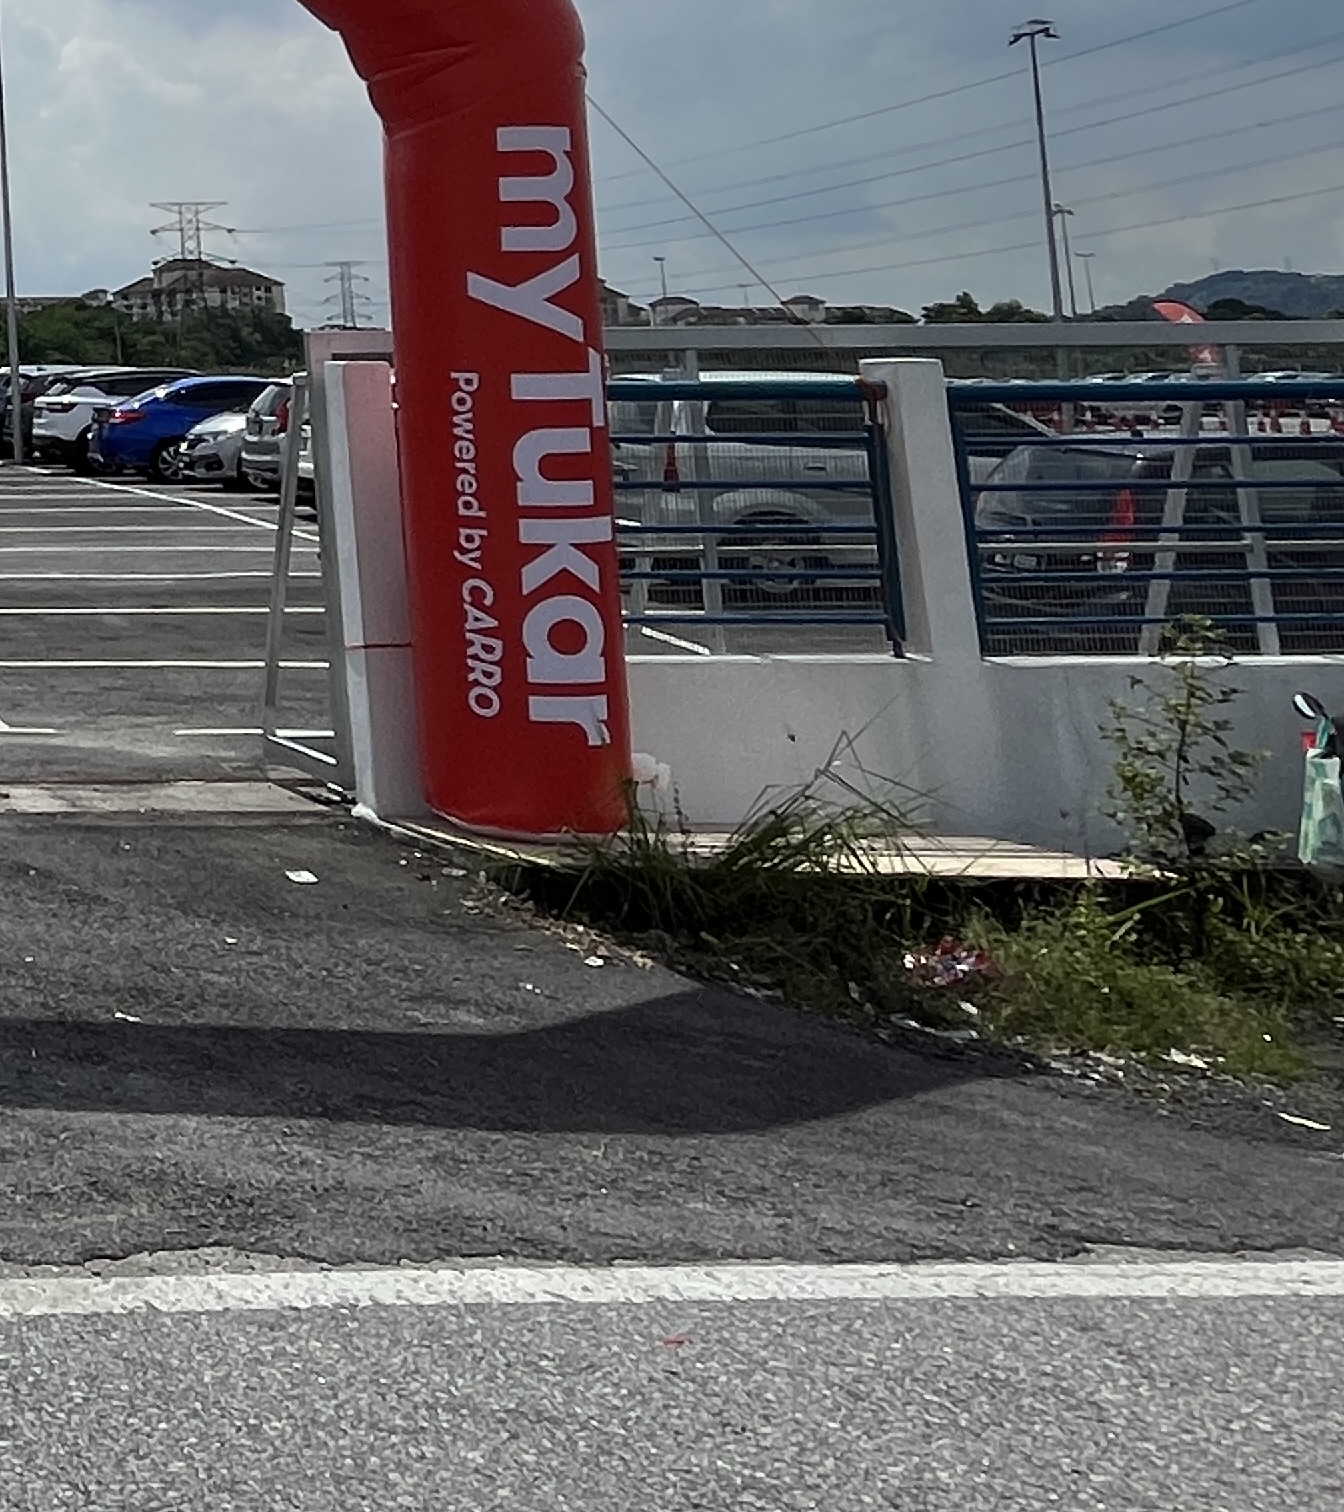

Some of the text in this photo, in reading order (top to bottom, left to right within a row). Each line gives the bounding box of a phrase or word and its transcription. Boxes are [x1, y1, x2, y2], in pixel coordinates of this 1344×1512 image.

[450, 372, 504, 718] Powered by CARRO
[466, 125, 612, 747] myTukar
